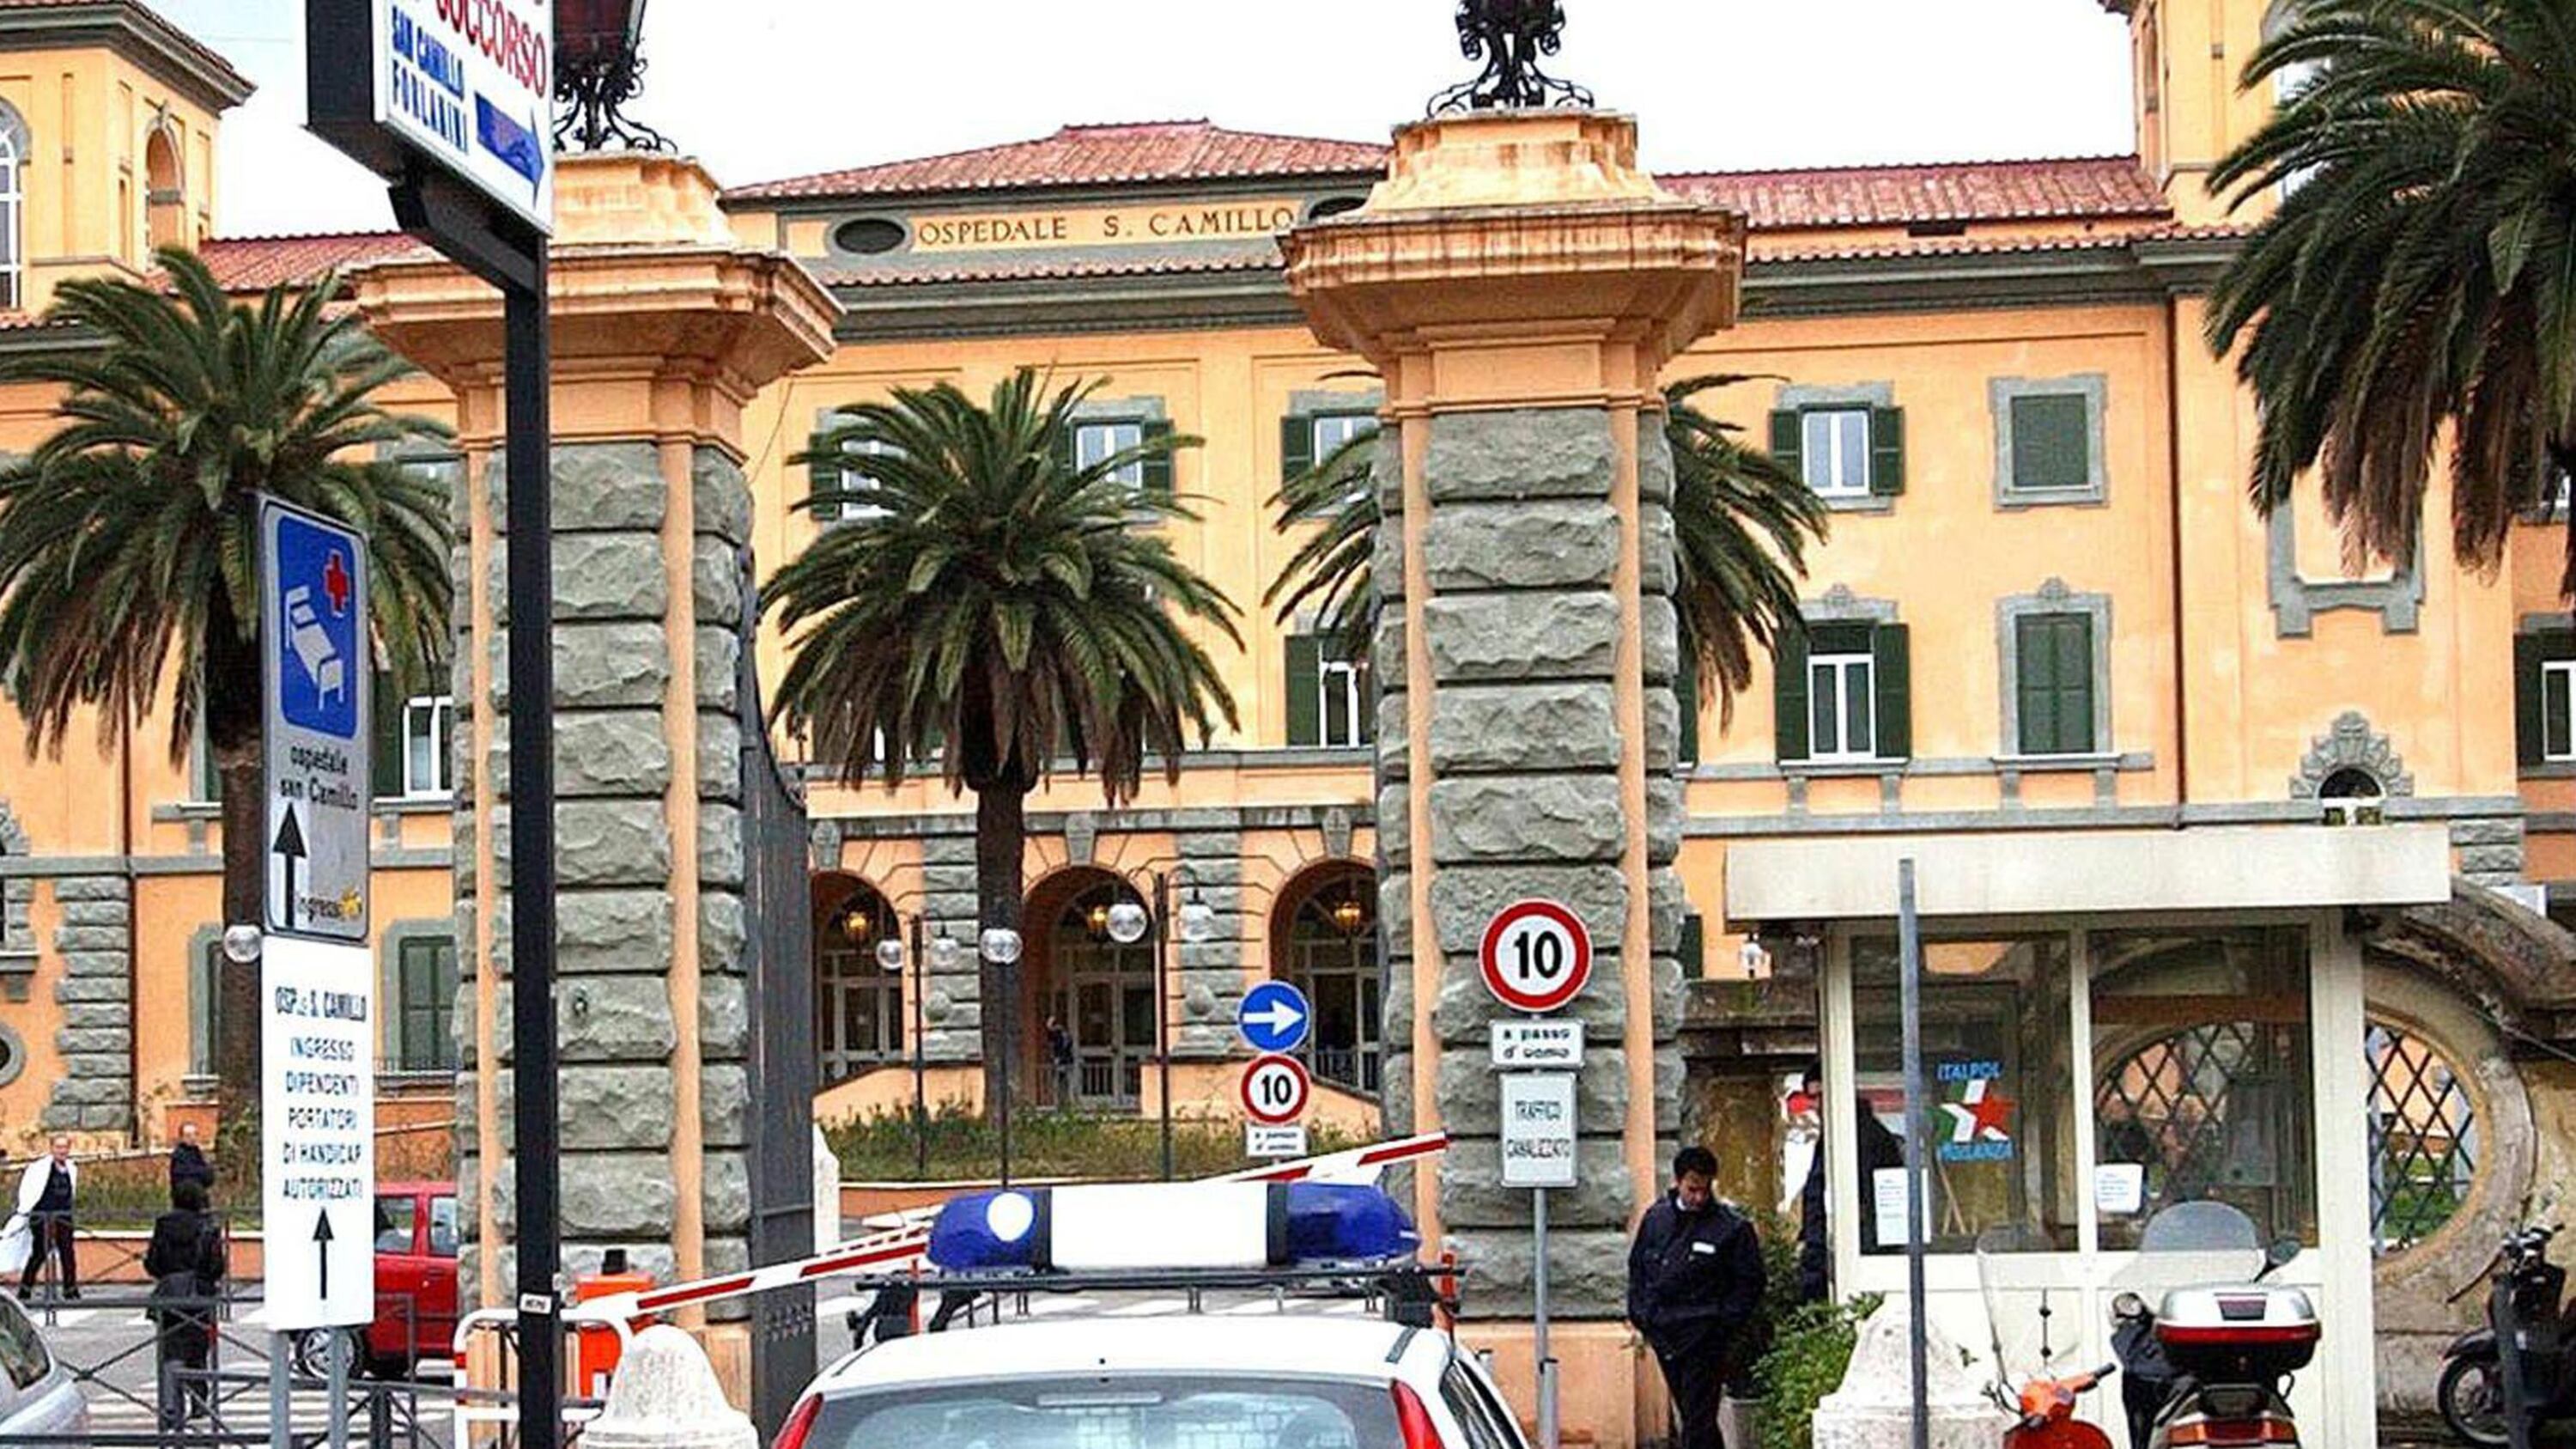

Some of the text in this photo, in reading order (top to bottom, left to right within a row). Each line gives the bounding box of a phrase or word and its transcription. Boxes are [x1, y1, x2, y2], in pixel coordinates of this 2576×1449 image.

[919, 208, 1294, 245] OSPEDALE S. CAMILLO
[291, 746, 348, 776] ospedale
[281, 776, 357, 810] san Camillo
[1514, 931, 1562, 979] 10
[290, 1037, 354, 1062] INGRESSO
[286, 1070, 359, 1096] DIPENDENTI
[1937, 1061, 2002, 1080] ITALPOL
[1261, 1075, 1292, 1105] 10
[288, 1107, 357, 1130] PORTATORI
[283, 1142, 361, 1165] DI HANDICAP
[283, 1177, 363, 1200] AUTORIZZATI
